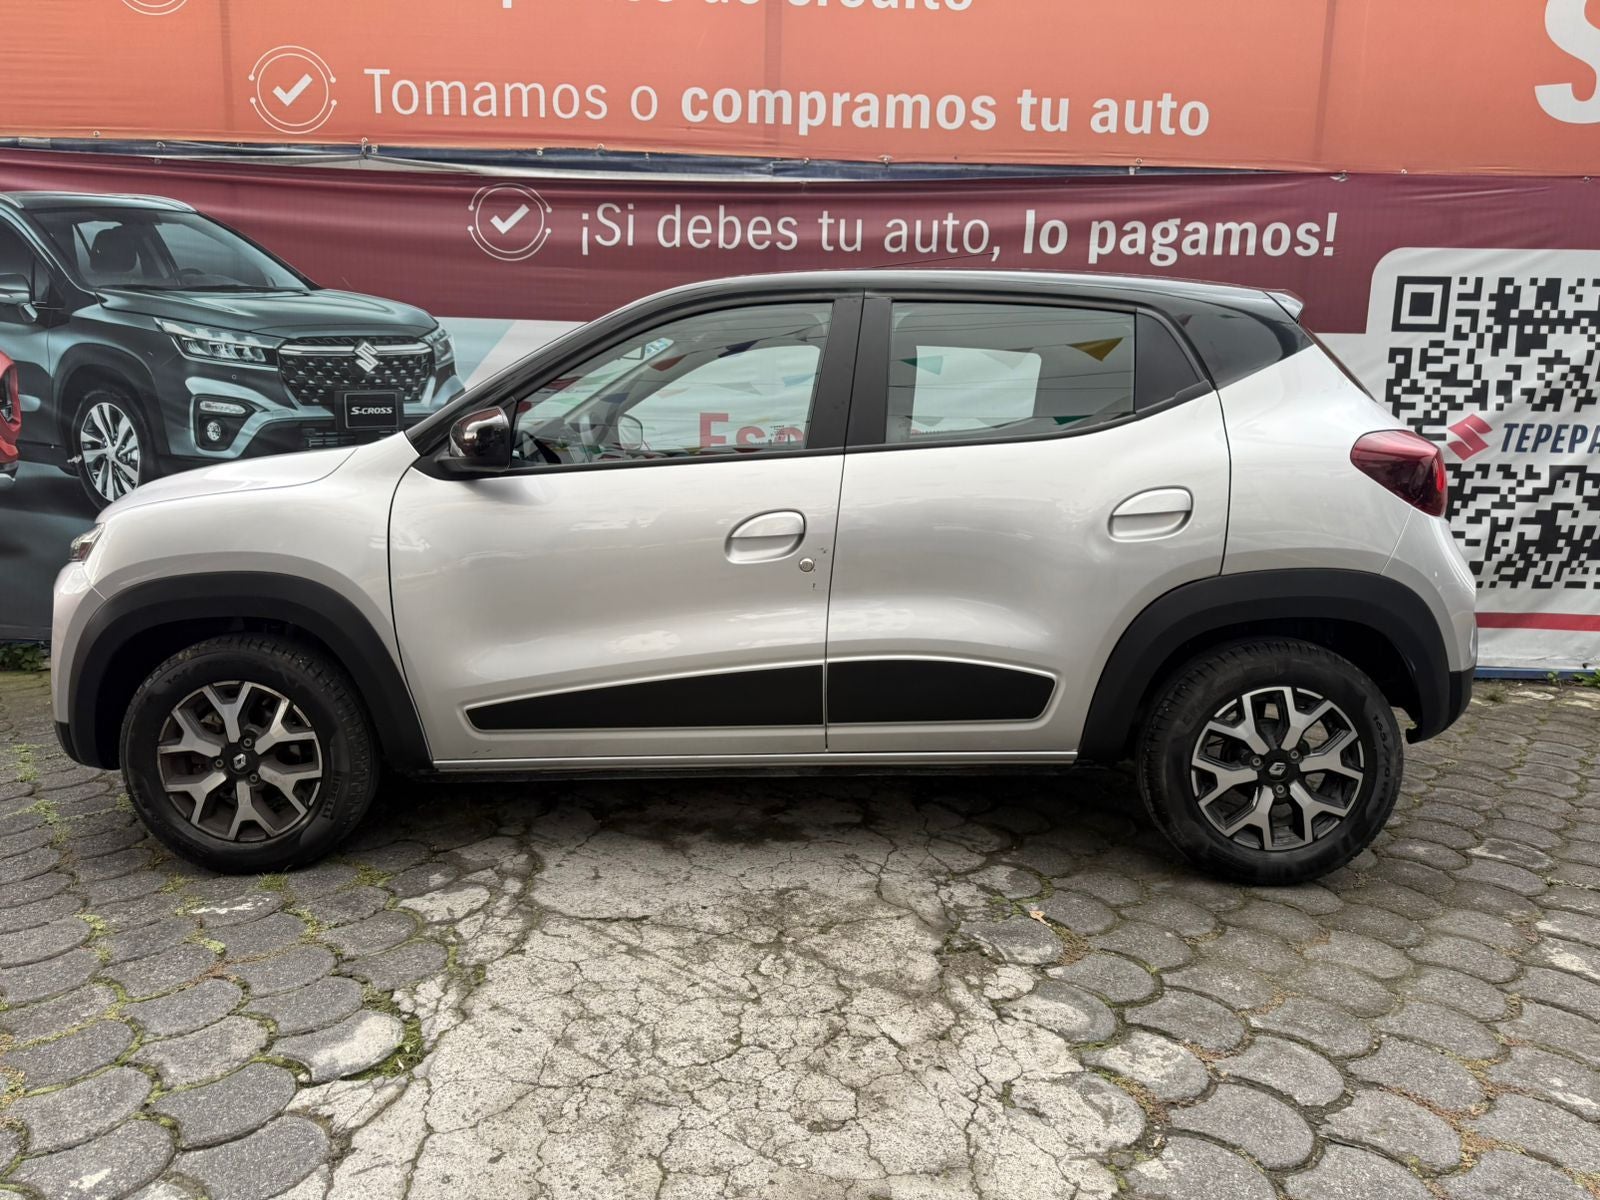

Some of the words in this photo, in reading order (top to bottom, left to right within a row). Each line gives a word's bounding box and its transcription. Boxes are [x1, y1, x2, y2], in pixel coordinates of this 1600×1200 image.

[364, 69, 608, 119] Tomamos
[631, 85, 658, 121] o
[681, 86, 996, 135] compramos
[1017, 89, 1069, 132] tu
[1090, 93, 1210, 136] auto
[581, 203, 634, 255] ¡Si
[657, 205, 798, 251] debes
[818, 210, 862, 252] tu
[884, 211, 1000, 261] auto,
[1022, 209, 1068, 254] lo
[1088, 213, 1338, 266] pagamos!
